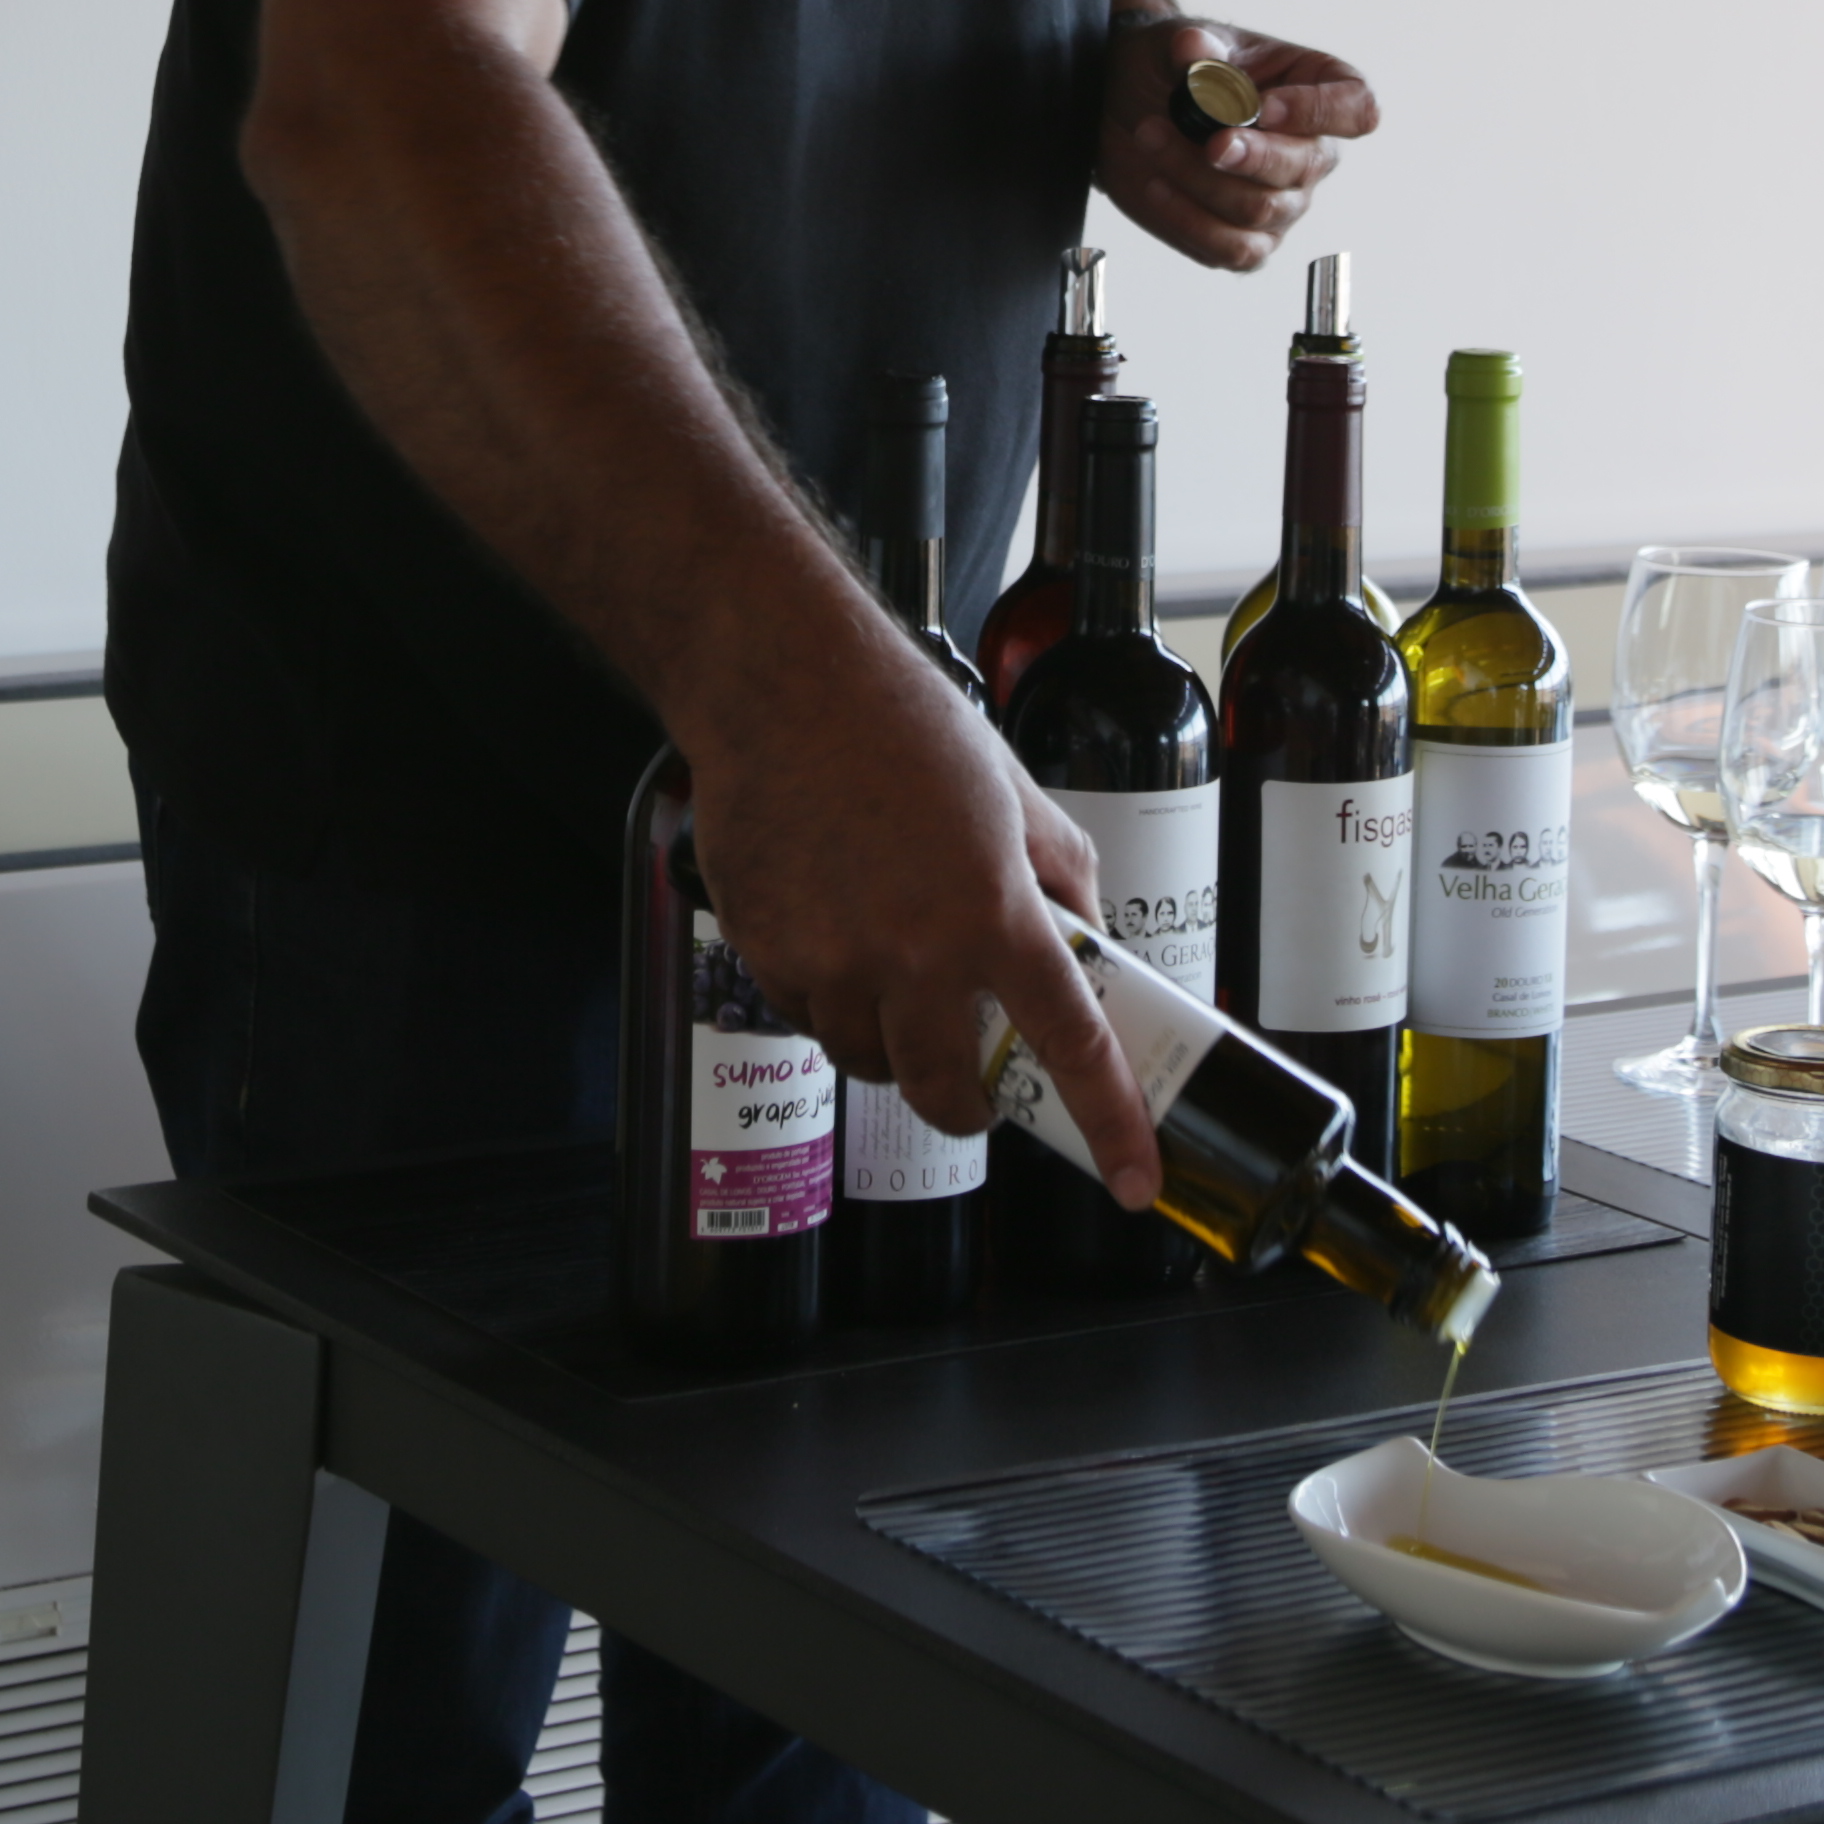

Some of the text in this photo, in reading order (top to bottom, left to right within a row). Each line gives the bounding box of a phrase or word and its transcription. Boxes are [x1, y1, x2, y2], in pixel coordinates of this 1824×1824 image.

[1438, 873, 1512, 901] Velha
[713, 1046, 824, 1089] sumo de
[738, 1097, 810, 1130] grape
[857, 1159, 979, 1192] DOURO
